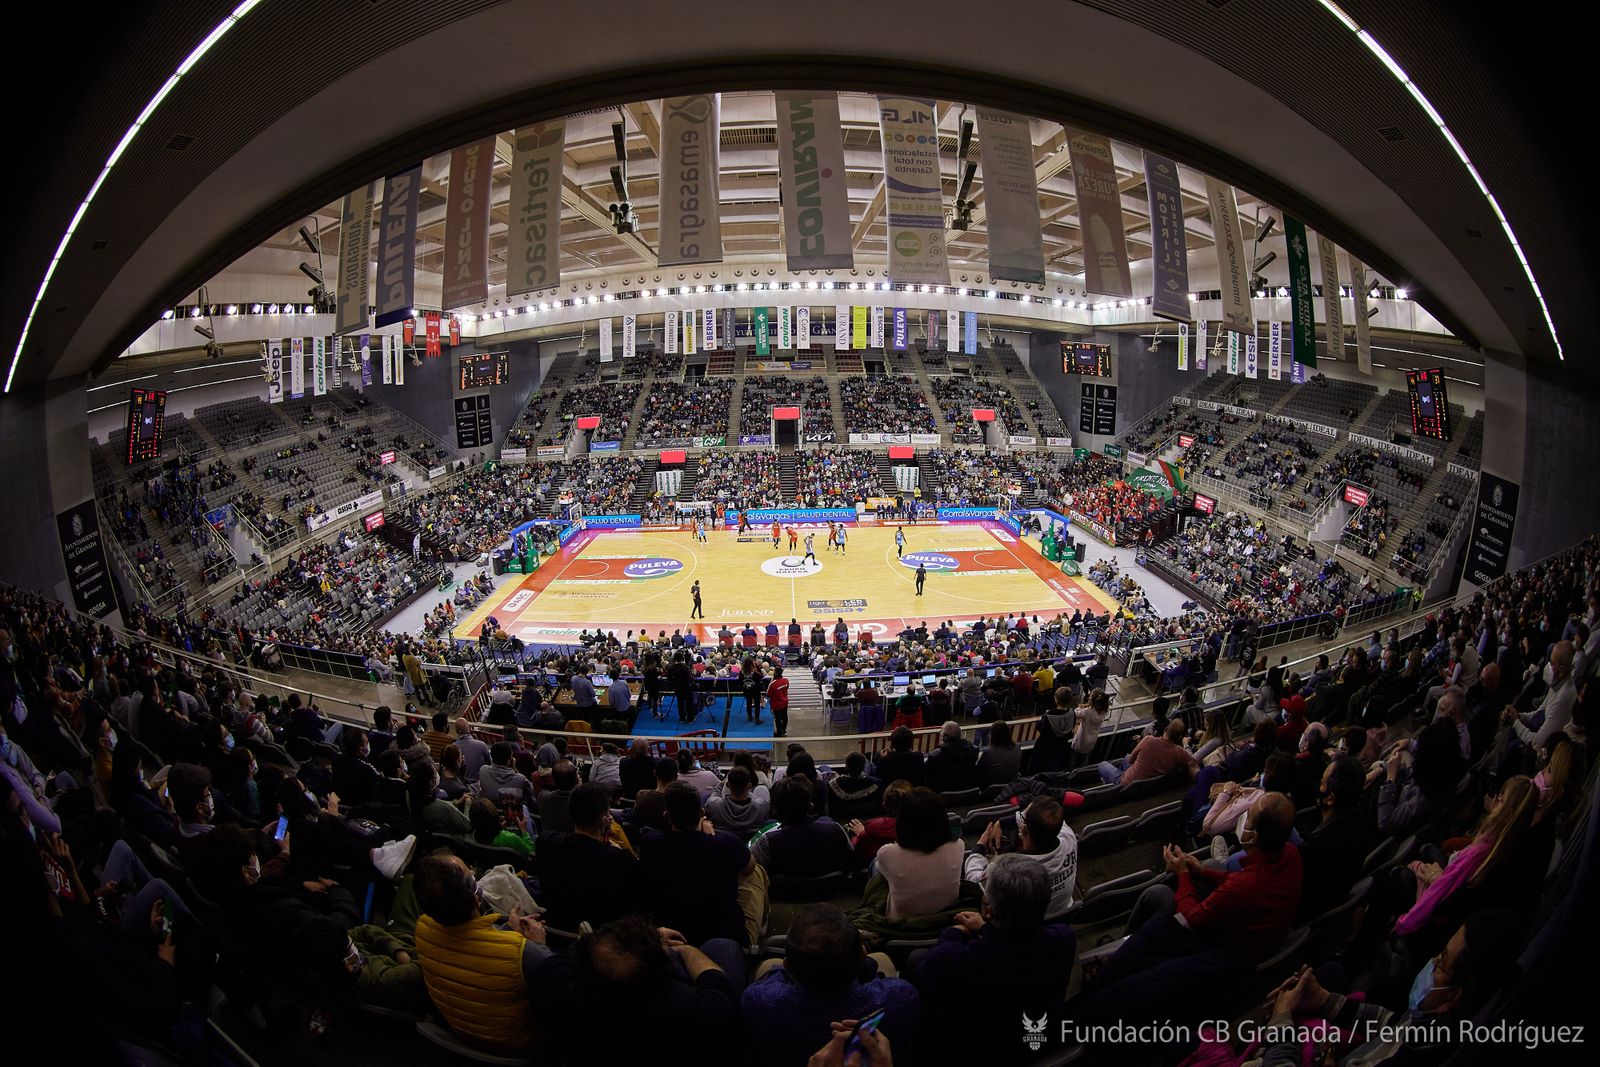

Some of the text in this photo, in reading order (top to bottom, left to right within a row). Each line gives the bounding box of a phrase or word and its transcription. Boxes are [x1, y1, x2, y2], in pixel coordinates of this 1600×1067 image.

[1298, 264, 1312, 347] CAJA RURAL
[838, 311, 847, 345] JURAND
[895, 310, 904, 347] PULEVA
[270, 347, 282, 393] Jeep
[315, 339, 324, 393] COVIRAN
[1199, 401, 1216, 410] IDEAL
[1236, 407, 1254, 418] IDEAL
[1312, 423, 1336, 437] IDEAL
[703, 435, 723, 447] CSIF
[1350, 433, 1432, 465] IDEAL IDEAL IDEAL
[1449, 463, 1476, 480] IDEAL
[337, 503, 353, 515] asisa
[729, 510, 854, 523] Cal&Vargas SALUD DENTAL
[942, 508, 996, 519] Corral&Vargas
[1479, 500, 1514, 522] AYUNTAMIENTO
[587, 517, 609, 525] SALUD
[1480, 511, 1509, 529] DE GRANADA
[64, 530, 99, 552] AYUNTAMIENTO
[68, 540, 97, 560] DE GRANADA
[904, 553, 957, 564] PULEVA
[629, 559, 679, 570] PULEVA
[718, 608, 774, 618] JURAND
